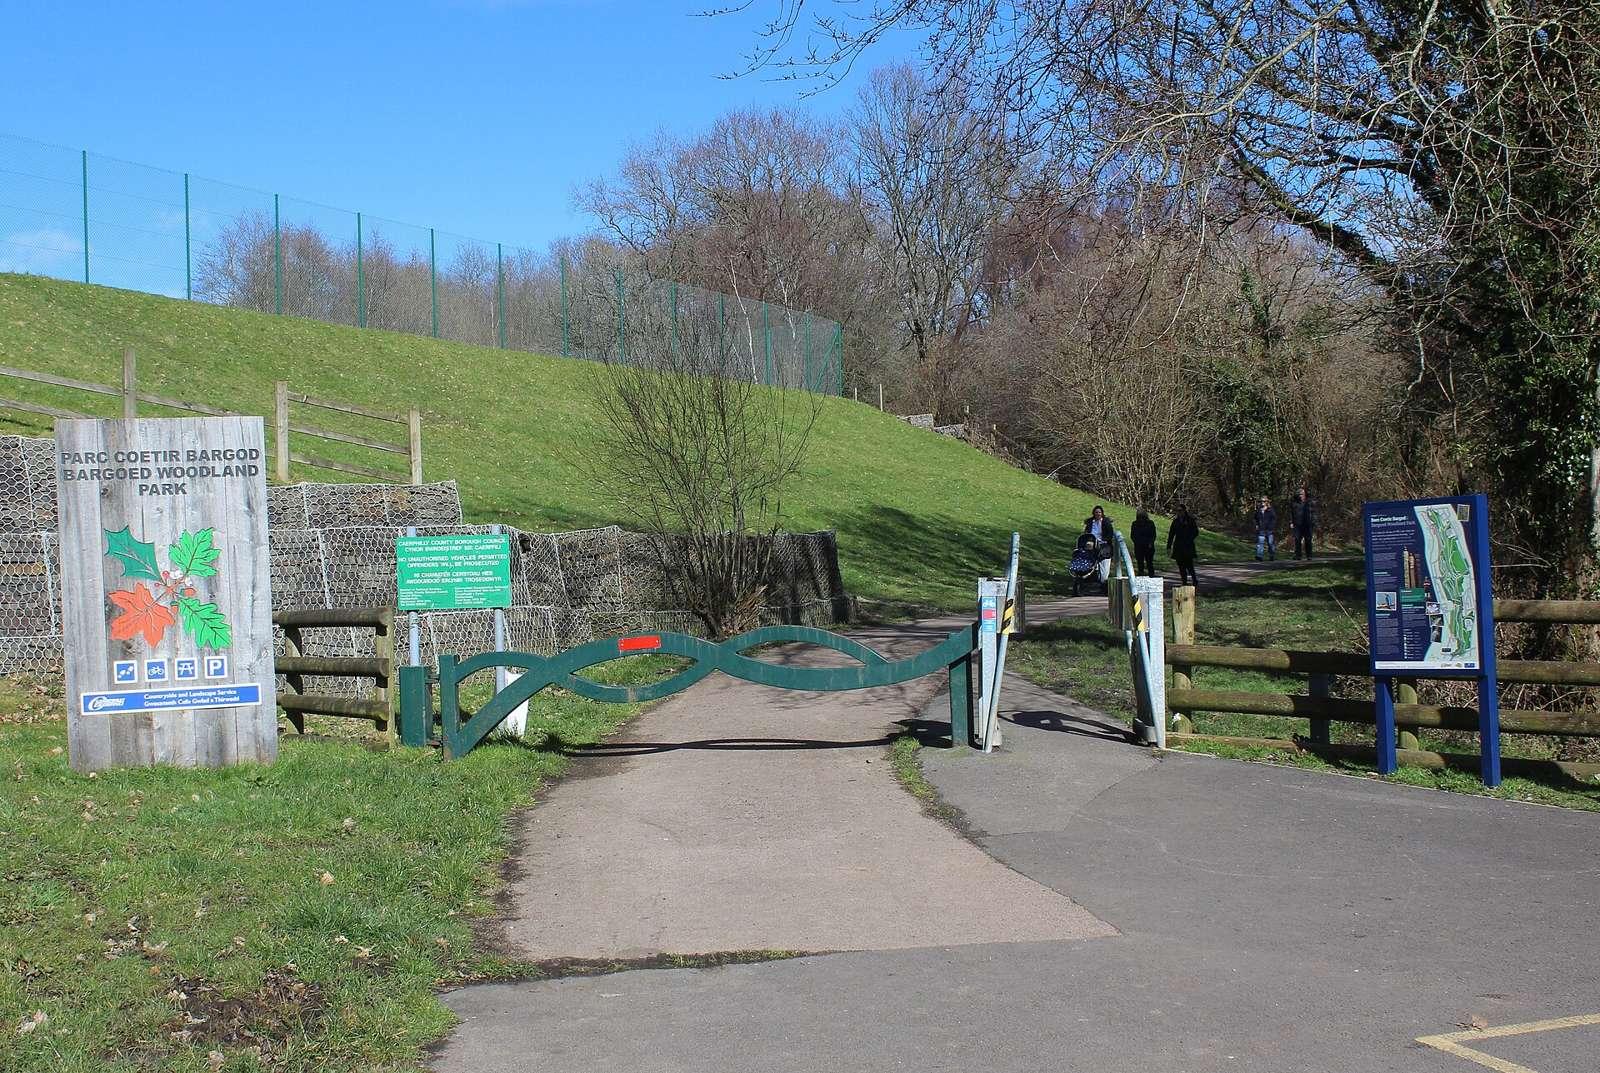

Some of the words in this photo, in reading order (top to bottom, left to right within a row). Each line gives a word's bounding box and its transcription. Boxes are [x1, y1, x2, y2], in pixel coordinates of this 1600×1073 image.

[61, 451, 108, 464] PARC
[114, 450, 180, 464] COETIR
[186, 448, 260, 462] BARGOD
[62, 467, 151, 481] BARGOED
[157, 464, 260, 480] WOODLAND
[138, 482, 188, 496] PARK
[210, 660, 222, 675] P
